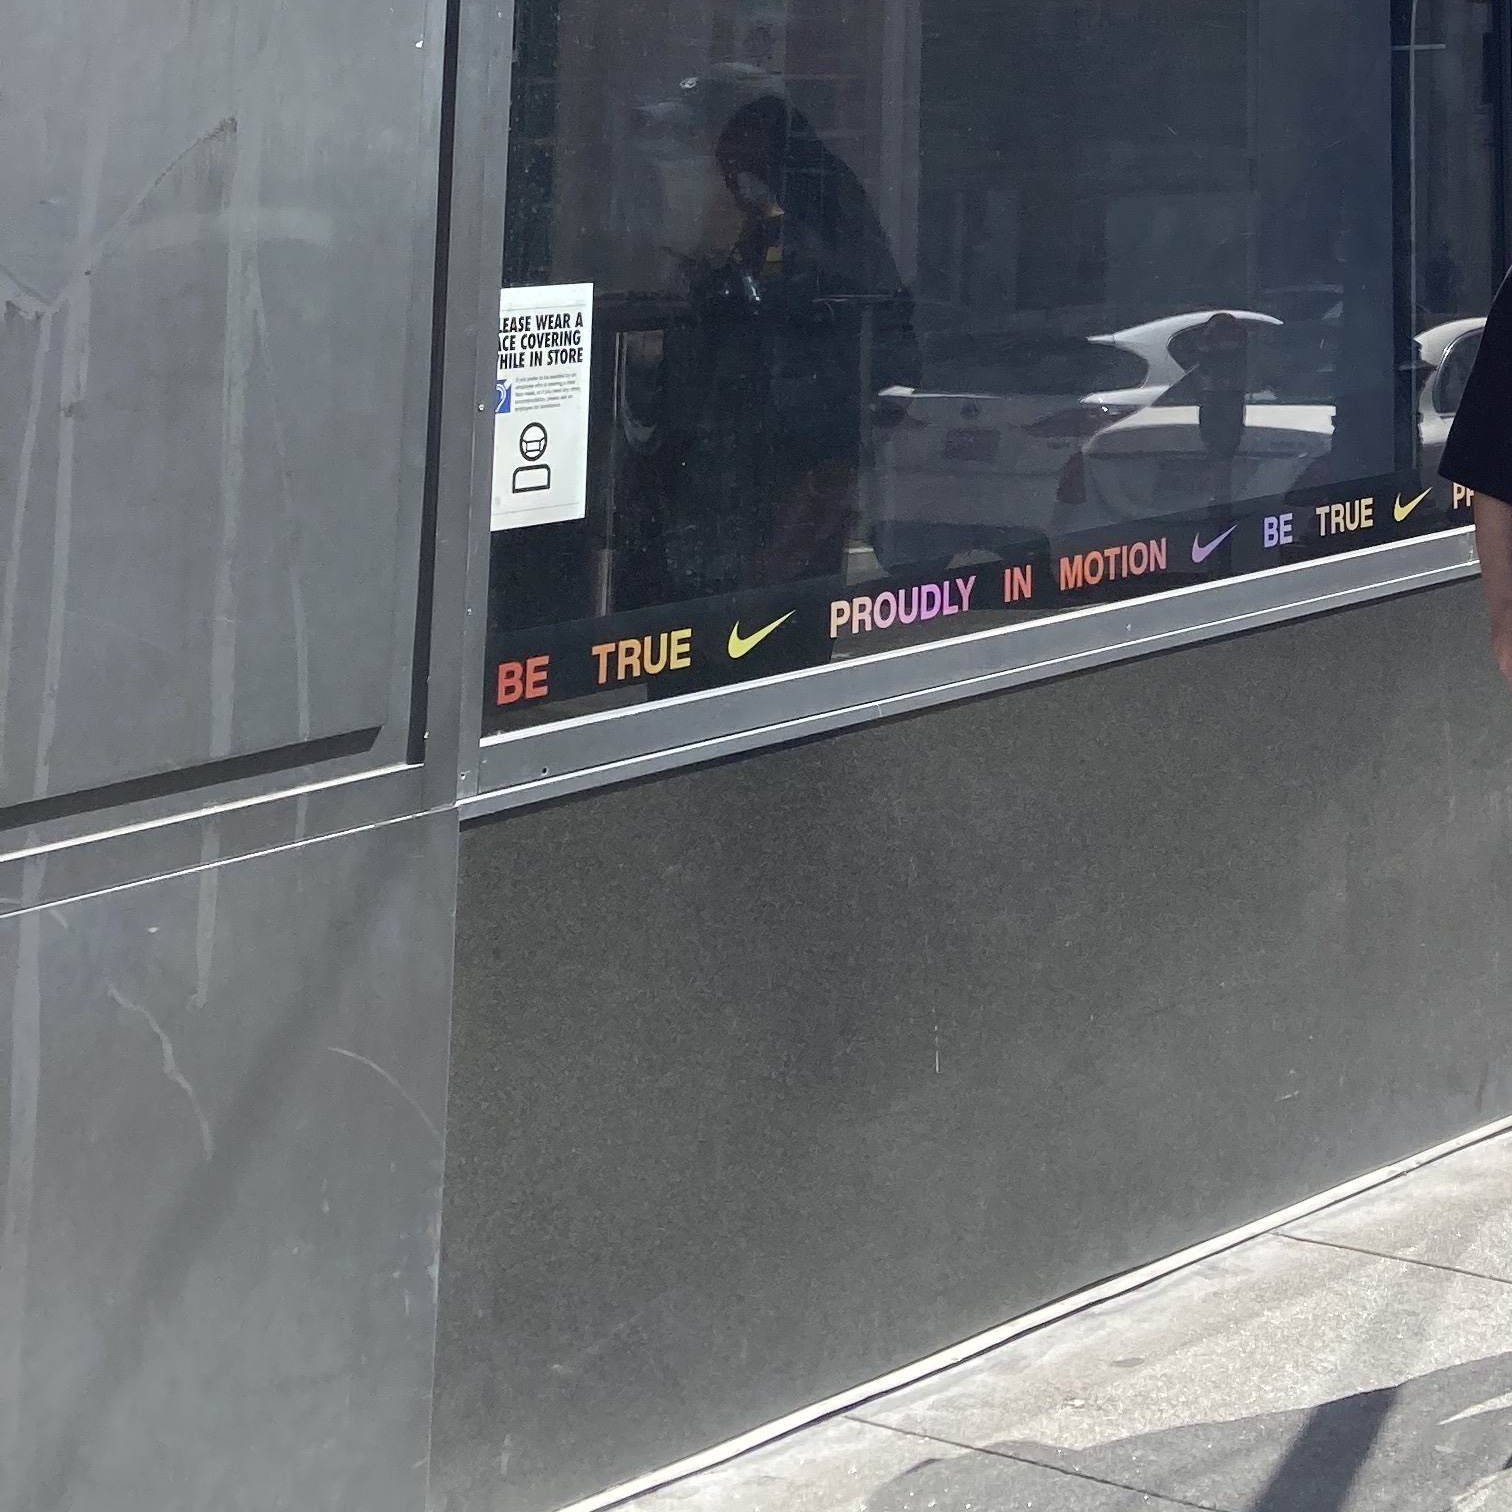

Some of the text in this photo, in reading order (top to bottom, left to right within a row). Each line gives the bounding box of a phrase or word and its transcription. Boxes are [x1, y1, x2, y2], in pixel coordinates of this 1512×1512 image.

[499, 312, 584, 333] EASE WEAR A
[520, 330, 581, 350] COVERING
[499, 347, 583, 369] HILE IN STORE
[496, 655, 549, 706] BE
[592, 628, 692, 685] TRUE
[830, 575, 976, 639] PROUDLY
[1003, 565, 1032, 603] IN
[1059, 537, 1168, 591] MOTION
[1263, 513, 1293, 549] BE
[1315, 497, 1374, 538] TRUE
